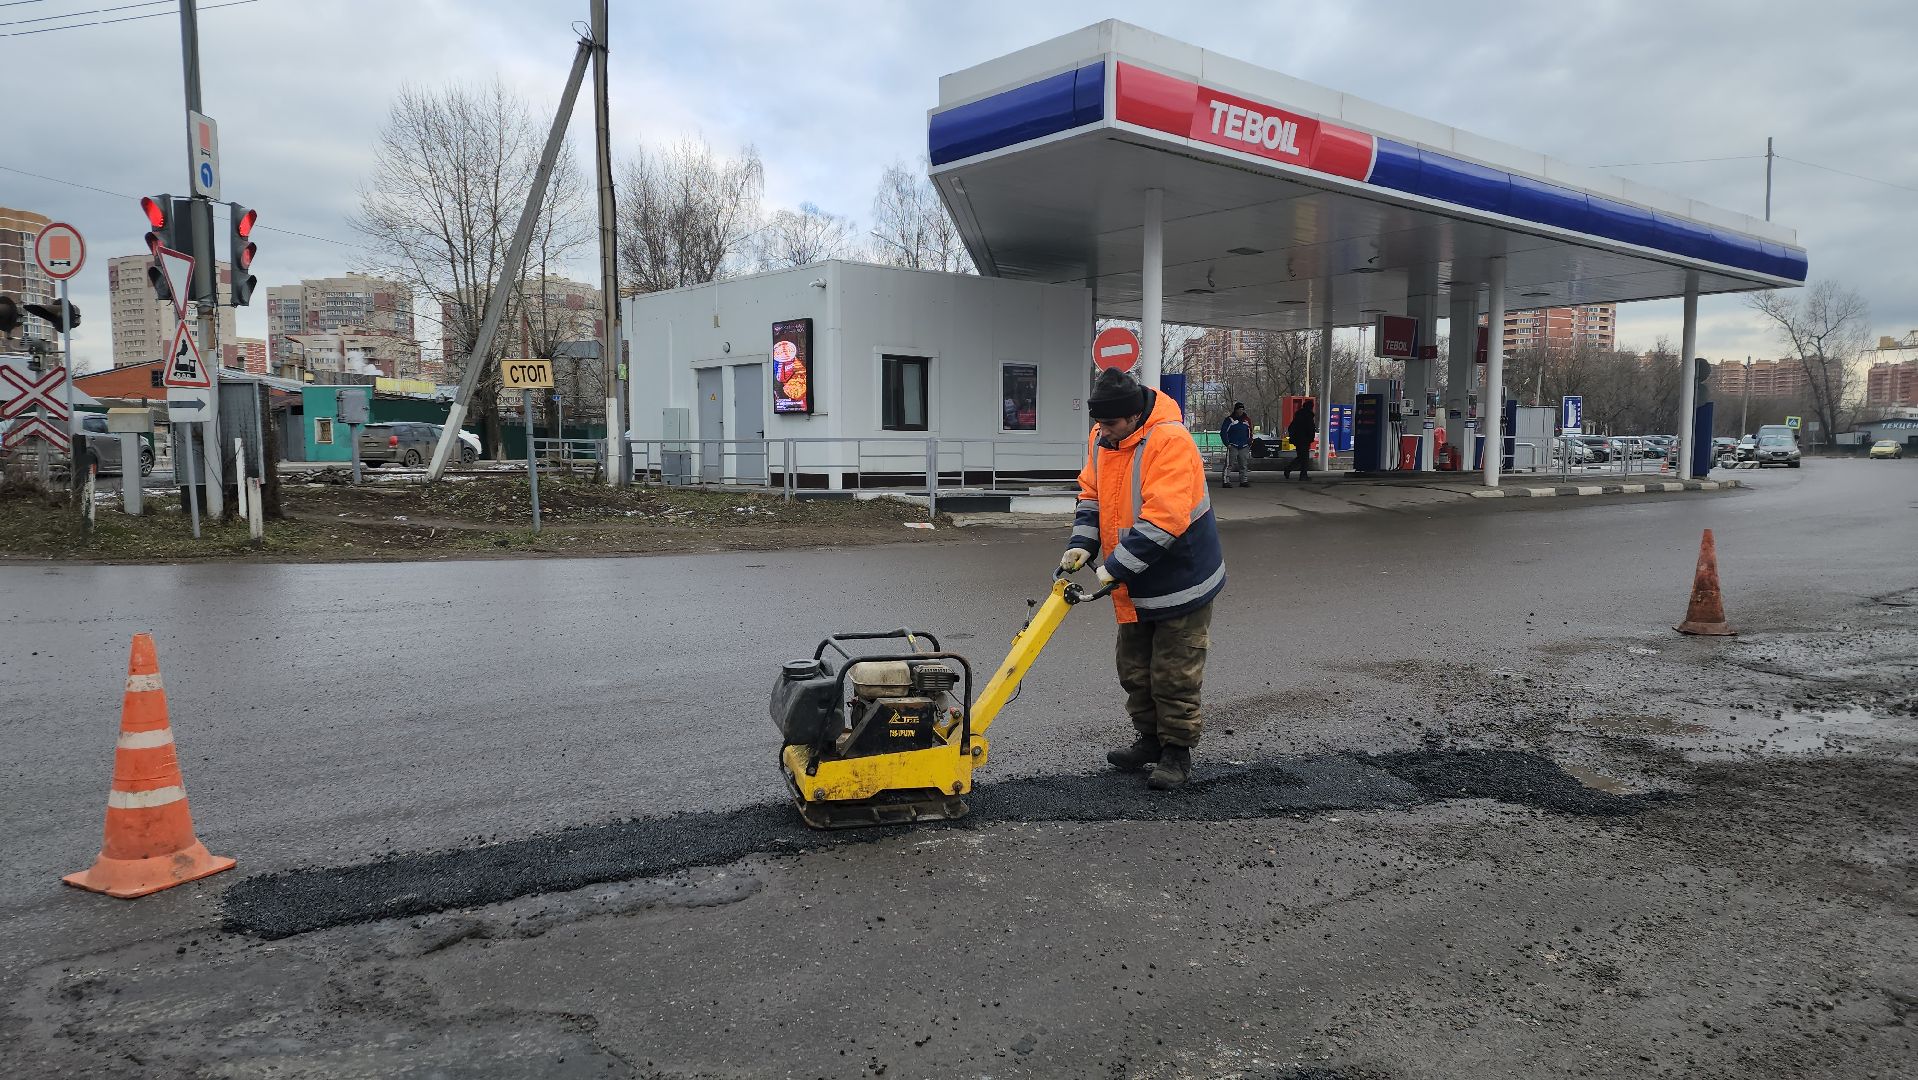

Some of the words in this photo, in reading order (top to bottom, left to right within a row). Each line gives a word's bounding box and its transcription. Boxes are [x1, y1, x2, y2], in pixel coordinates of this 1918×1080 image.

[1210, 100, 1300, 156] TEBOIL
[1385, 340, 1408, 352] TEBOIL
[510, 365, 547, 383] СТОП
[1405, 453, 1411, 464] 3
